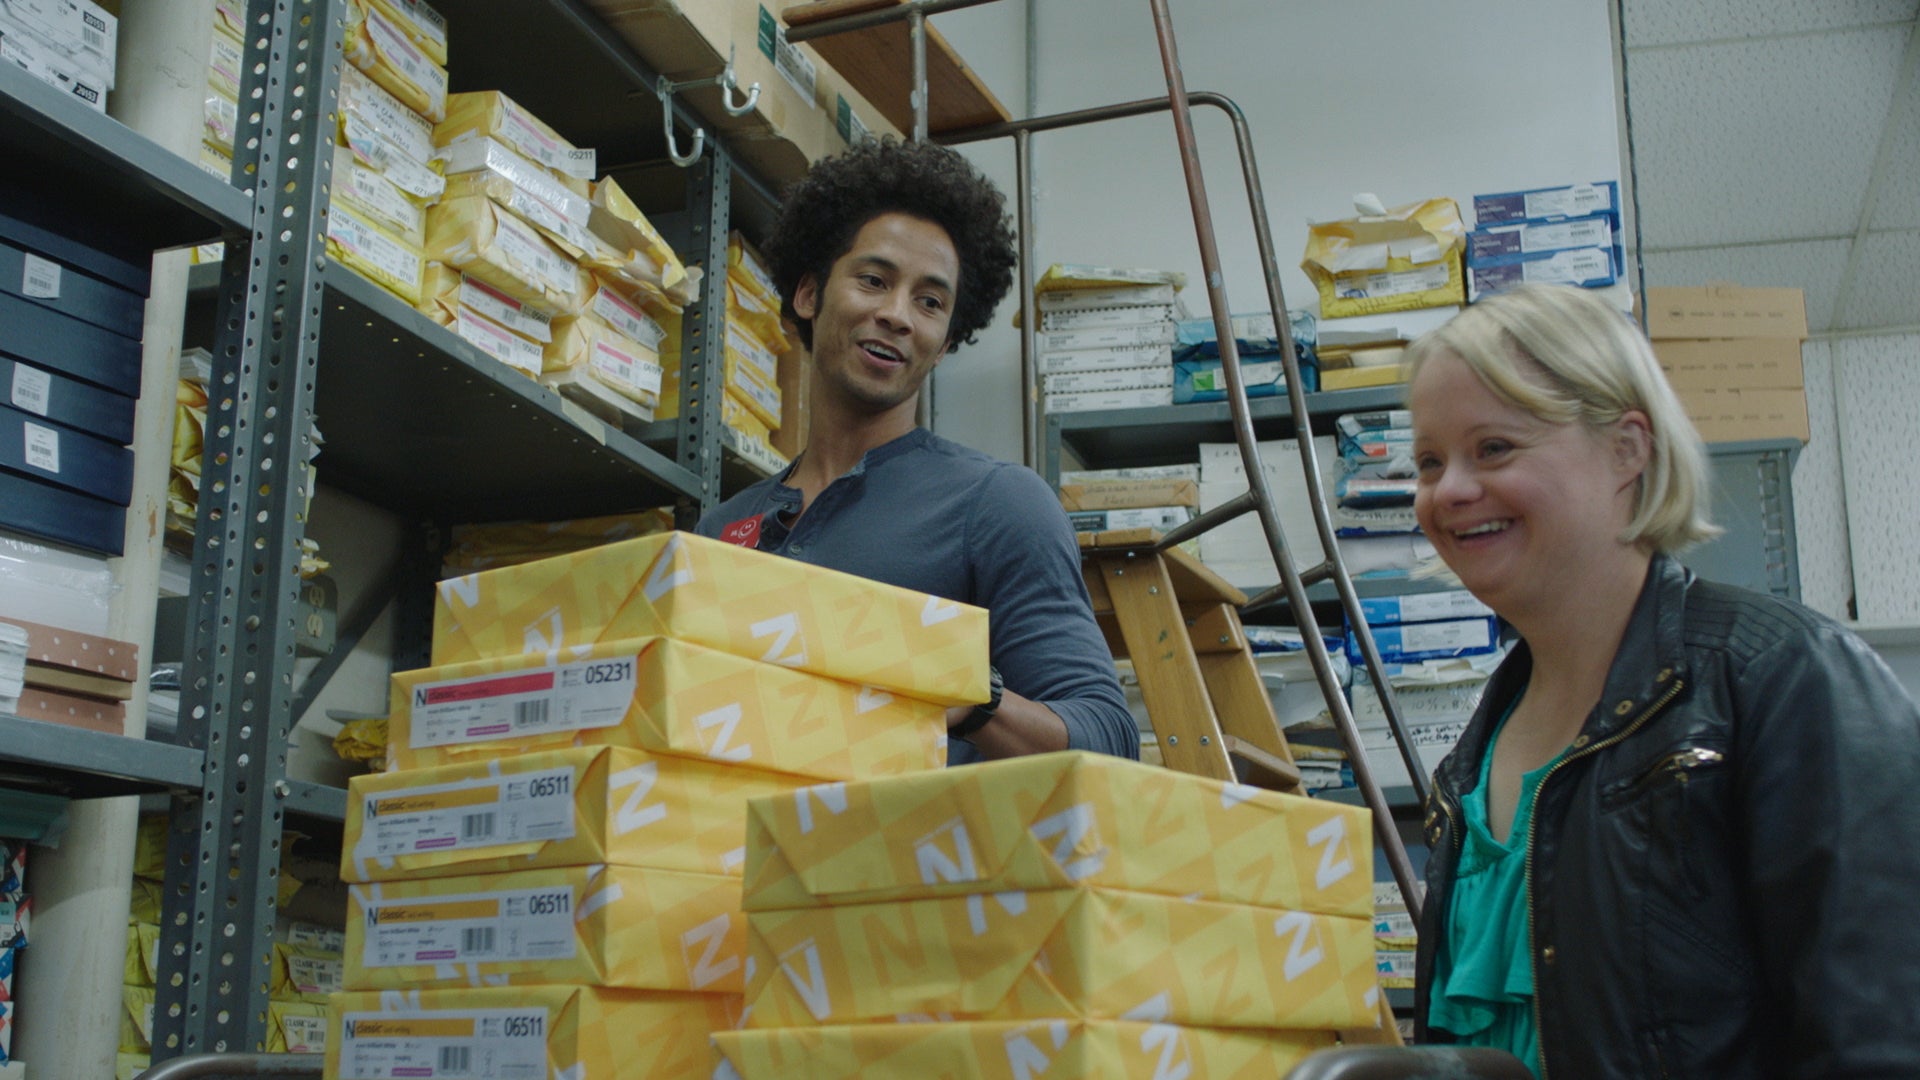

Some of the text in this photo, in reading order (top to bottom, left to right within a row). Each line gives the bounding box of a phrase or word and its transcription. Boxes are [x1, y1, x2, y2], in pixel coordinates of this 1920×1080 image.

[585, 662, 632, 685] 05231
[530, 775, 570, 798] 06511
[530, 894, 570, 915] 06511
[504, 1016, 543, 1038] 06511
